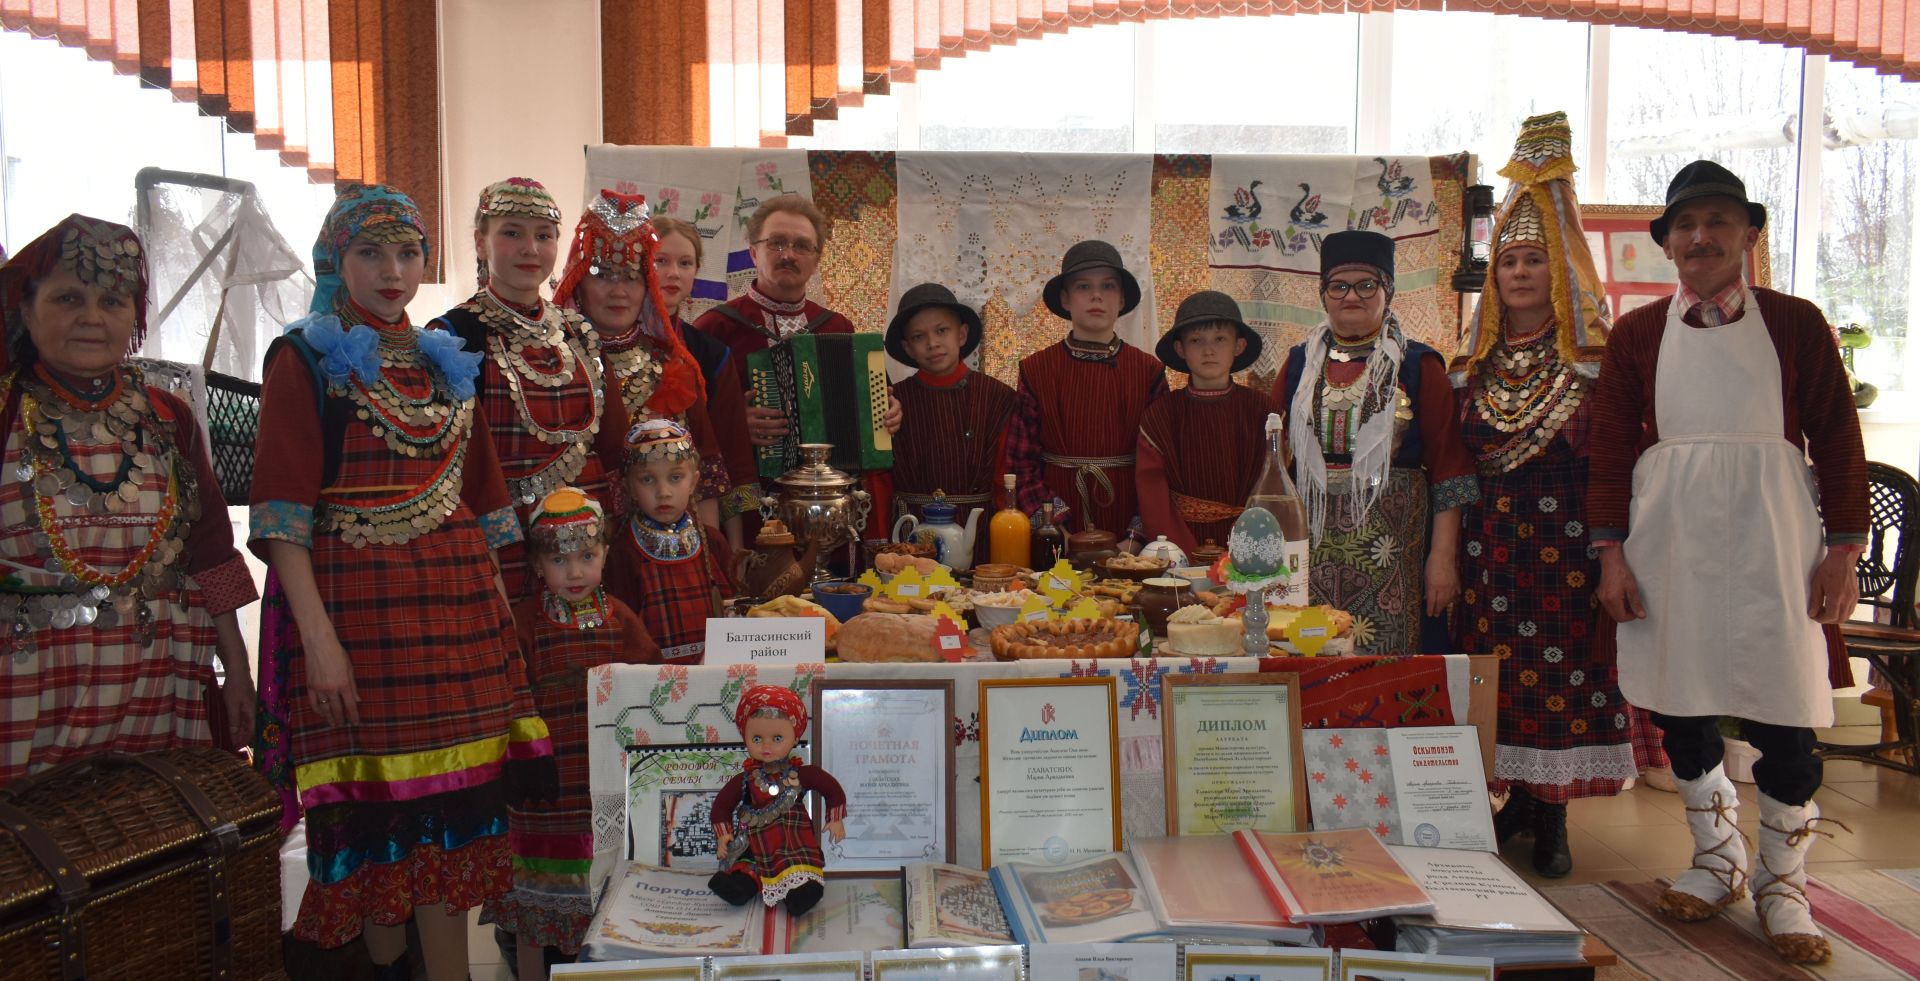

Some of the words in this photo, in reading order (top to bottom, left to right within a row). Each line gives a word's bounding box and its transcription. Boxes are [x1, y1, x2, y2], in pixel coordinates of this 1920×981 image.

[726, 631, 812, 642] Балтасинский
[751, 646, 787, 660] район
[1197, 719, 1267, 734] ДИПЛОМ
[1020, 727, 1079, 743] Диплом
[848, 740, 919, 750] ПОЧЕТНАЯ
[856, 754, 916, 764] ГРАМОТА
[664, 762, 717, 772] РОДОВОЙ
[662, 775, 703, 786] СЕМЬИ
[636, 881, 716, 897] Портфол
